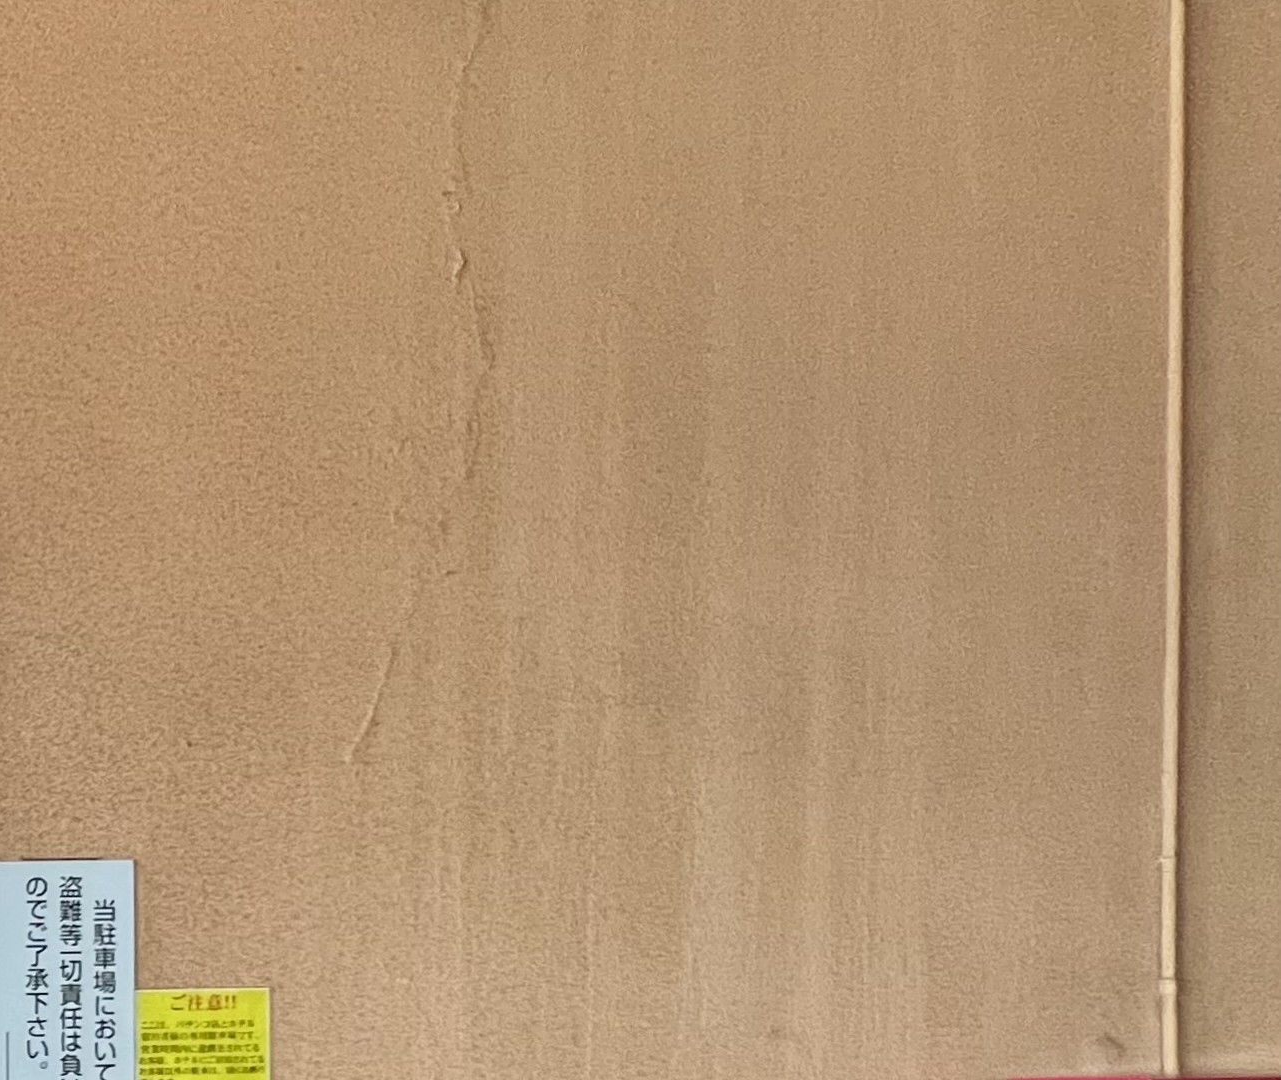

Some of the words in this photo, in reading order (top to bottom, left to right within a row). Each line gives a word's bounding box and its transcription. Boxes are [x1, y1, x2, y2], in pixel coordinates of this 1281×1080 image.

[26, 877, 50, 1070] のでご了承下さい。
